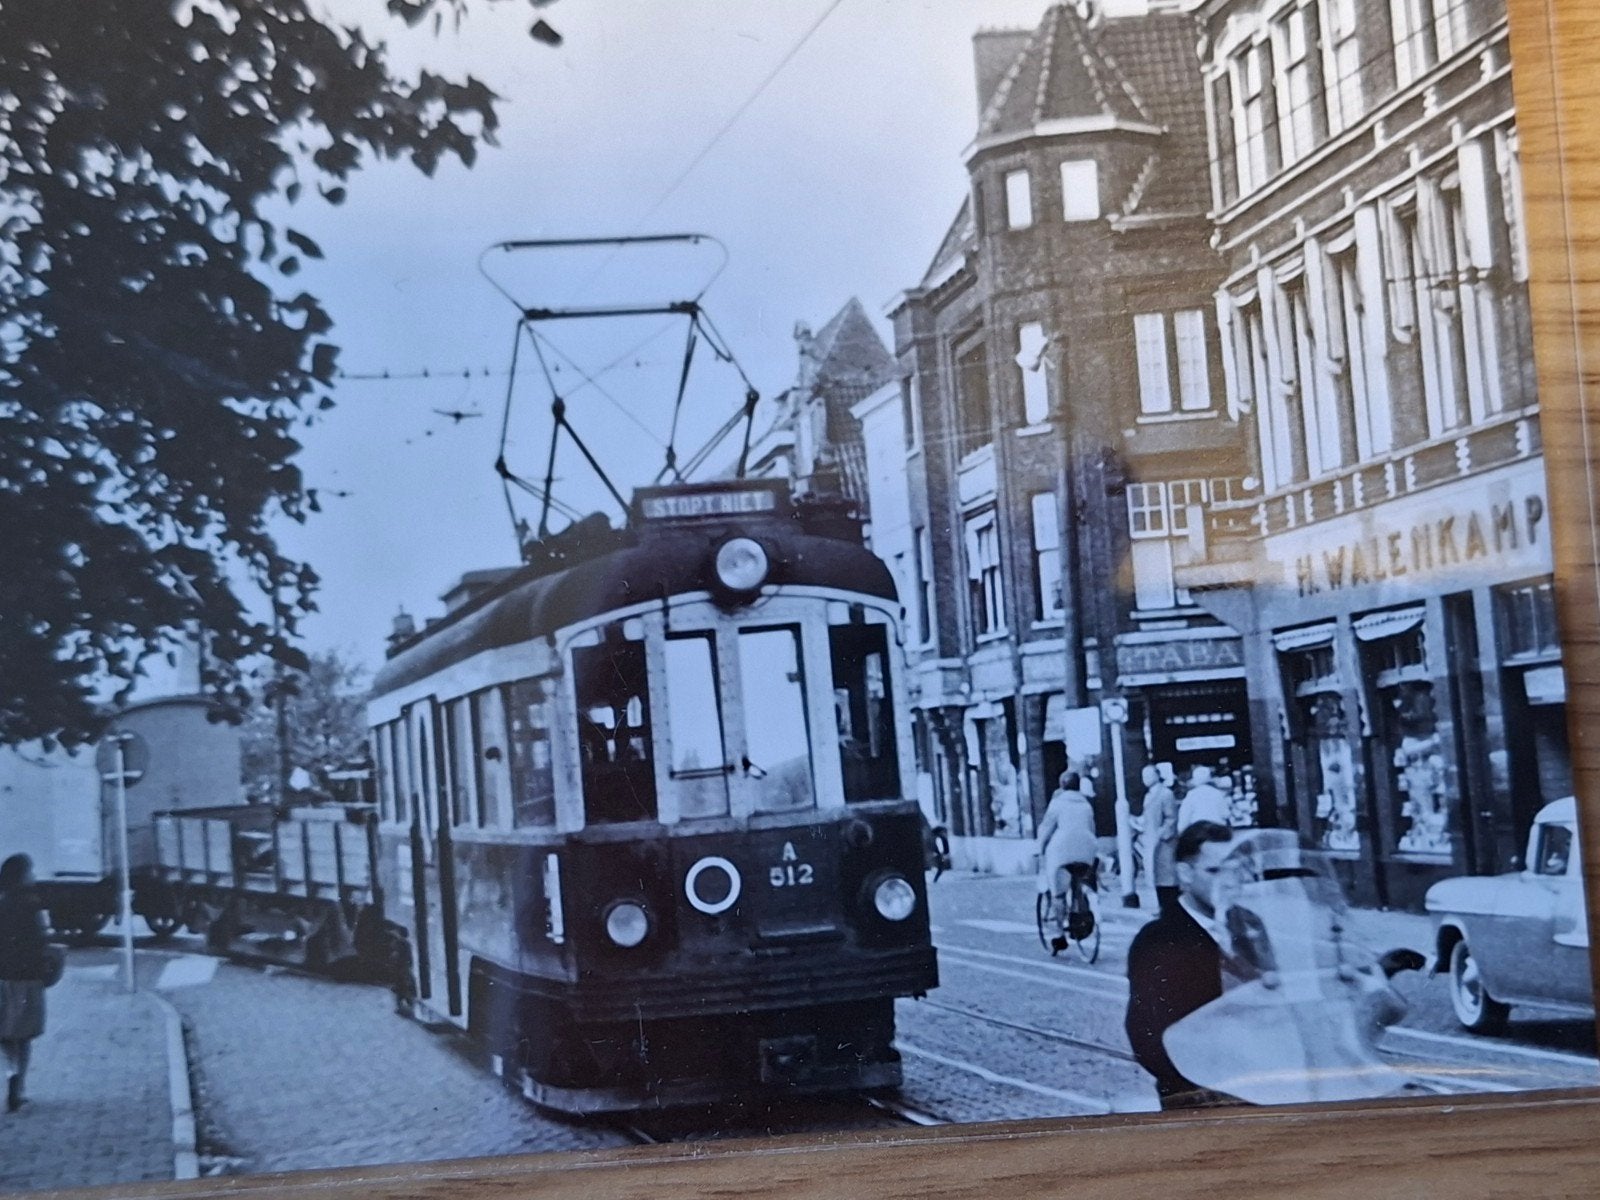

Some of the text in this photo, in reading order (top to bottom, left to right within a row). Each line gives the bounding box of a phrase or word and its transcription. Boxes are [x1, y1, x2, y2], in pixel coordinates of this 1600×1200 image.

[1323, 494, 1544, 591] WALENKAMP
[782, 841, 798, 861] A
[769, 863, 814, 886] 512
